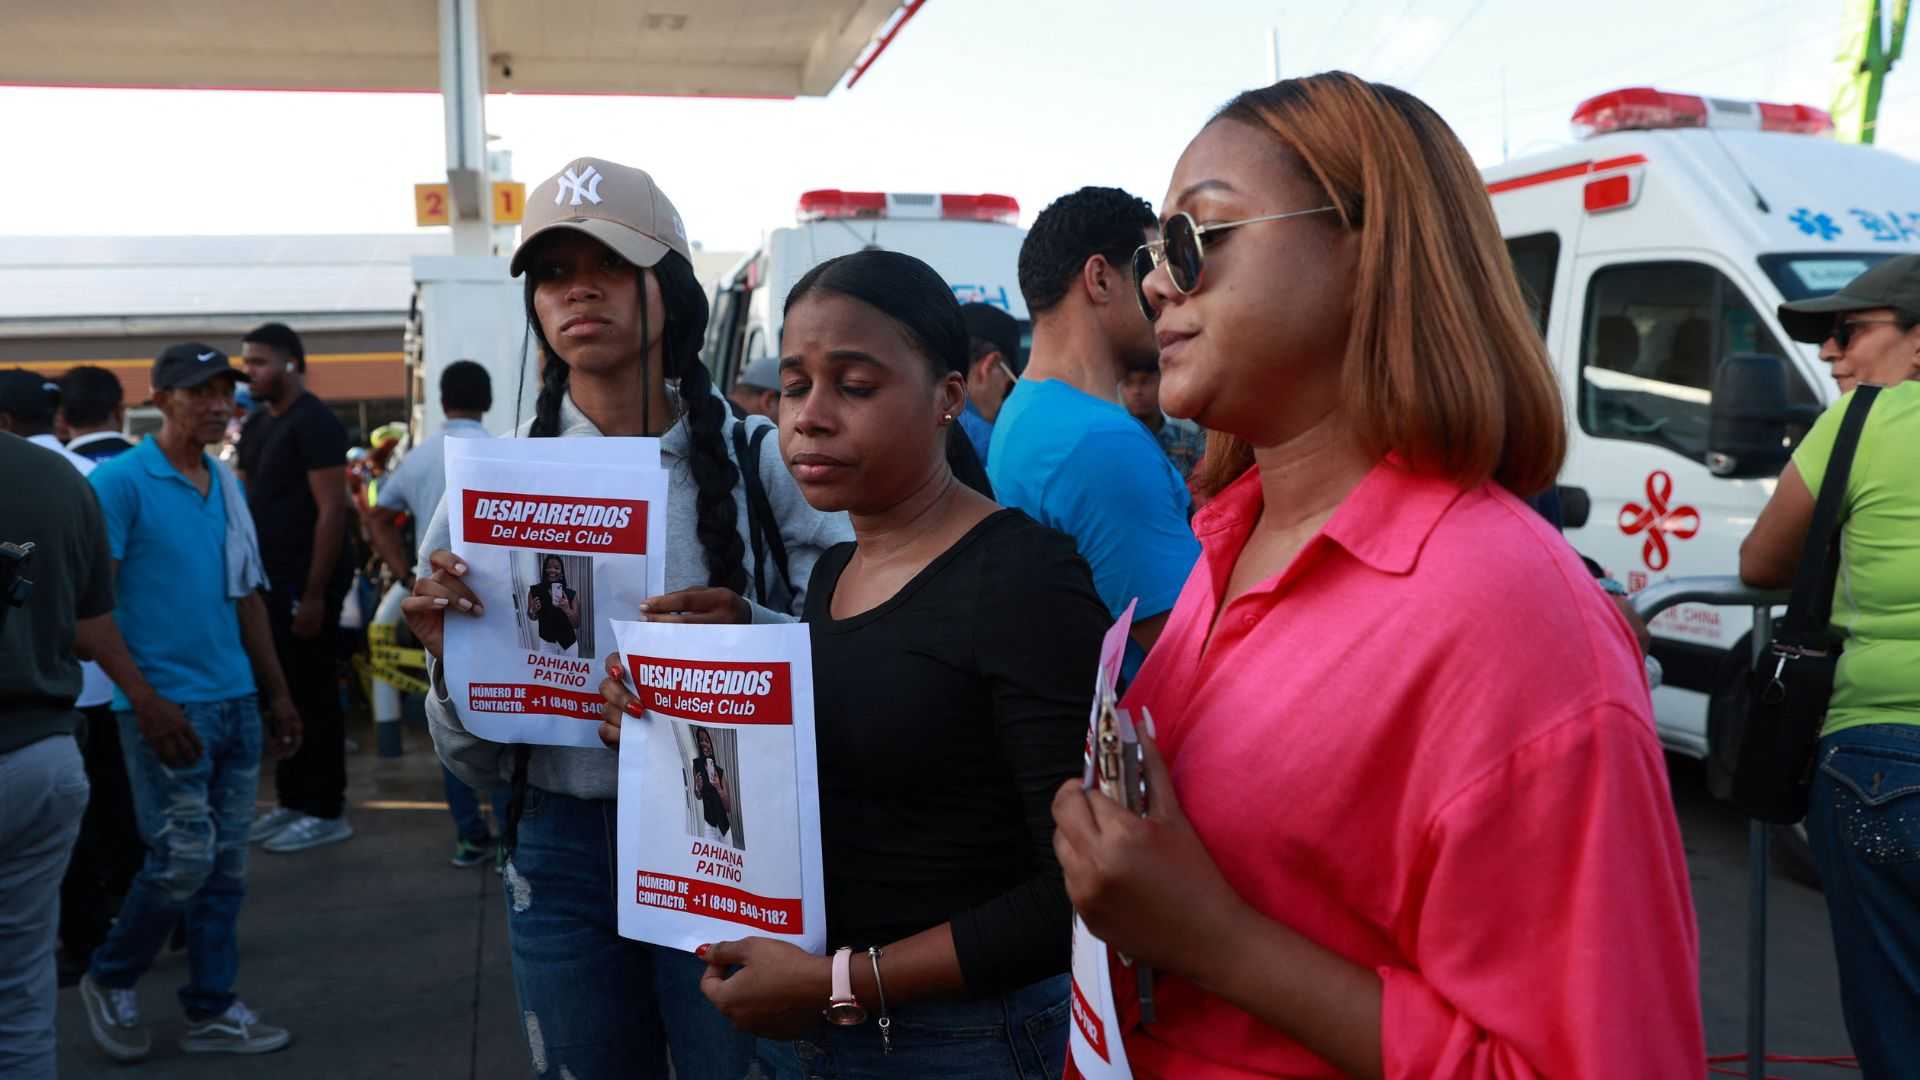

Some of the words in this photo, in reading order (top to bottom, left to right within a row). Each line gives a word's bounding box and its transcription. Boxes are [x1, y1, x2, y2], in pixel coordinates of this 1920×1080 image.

[555, 165, 603, 206] NY
[425, 192, 444, 215] 2
[501, 190, 513, 213] 1
[474, 498, 632, 529] DESAPARECIDOS
[491, 524, 517, 539] Del
[520, 526, 571, 543] JetSet
[575, 530, 613, 545] Club
[527, 654, 590, 675] DAHIANA
[534, 669, 586, 687] PATIÑO
[639, 663, 773, 696] DESAPARECIDOS
[471, 685, 511, 698] NÚMERO
[514, 687, 527, 698] DE
[472, 699, 526, 712] CONTACTO:
[531, 695, 546, 706] +1
[550, 697, 577, 711] (849)
[654, 692, 672, 707] Del
[674, 696, 714, 714] JetSet
[717, 700, 755, 716] Club
[691, 842, 744, 868] DAHIANA
[696, 860, 742, 882] PATIÑO
[639, 874, 676, 893] NÚMERO
[678, 881, 689, 895] DE
[638, 891, 688, 911] CONTACTO:
[693, 893, 707, 907] +1
[710, 894, 737, 913] (849)
[740, 901, 789, 925] 540-7182
